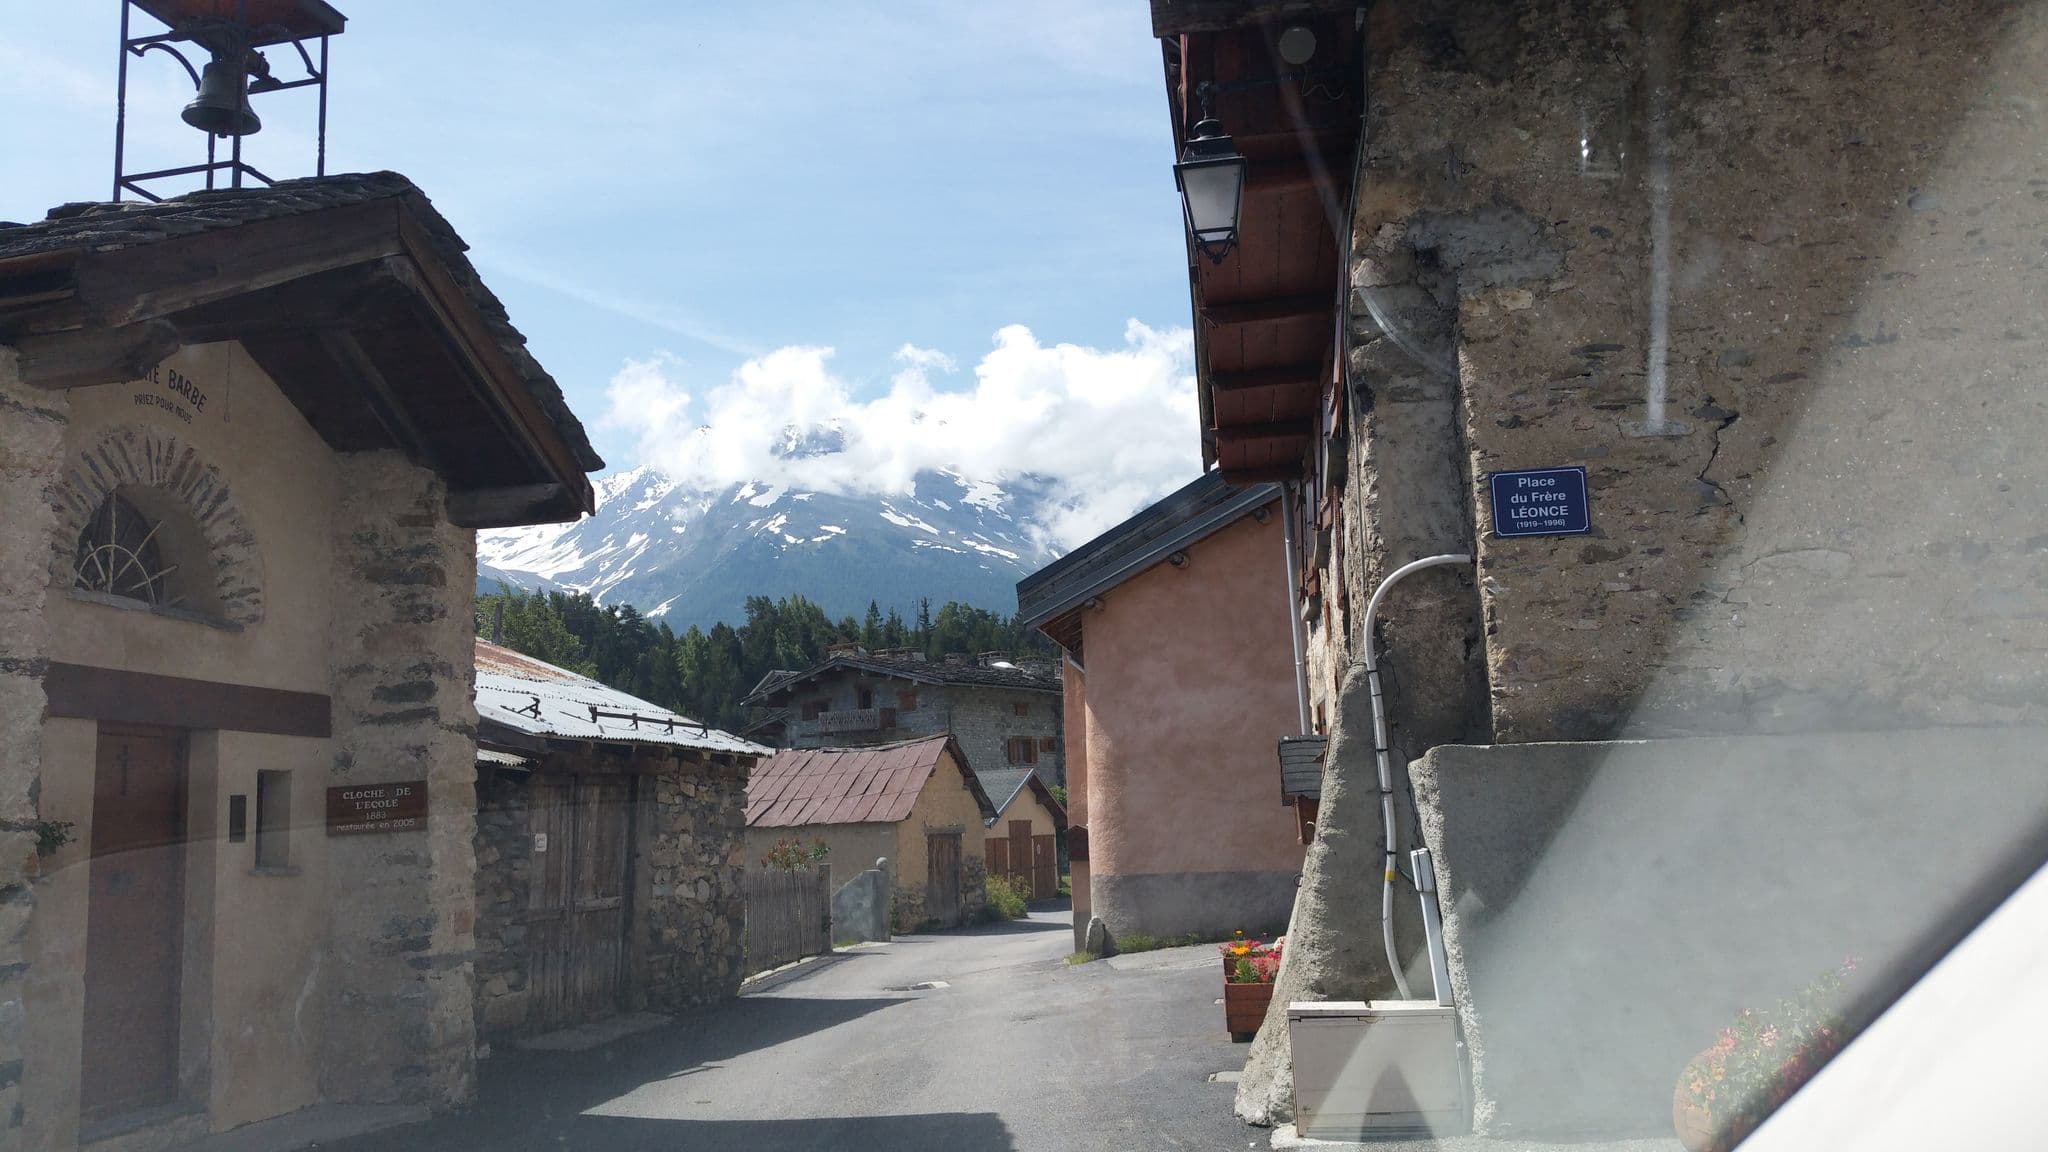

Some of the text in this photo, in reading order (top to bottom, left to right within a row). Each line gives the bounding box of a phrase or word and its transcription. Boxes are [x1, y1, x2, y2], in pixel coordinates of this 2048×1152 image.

[168, 368, 208, 413] BARBE
[134, 393, 193, 424] PRIEZ POUR NOUS
[1518, 477, 1555, 488] Place
[1510, 491, 1567, 504] du Frère
[1511, 505, 1569, 519] LÉONCE
[342, 787, 411, 800] CLOCHE DE
[336, 821, 376, 831] restaurée
[393, 818, 416, 828] 2005
